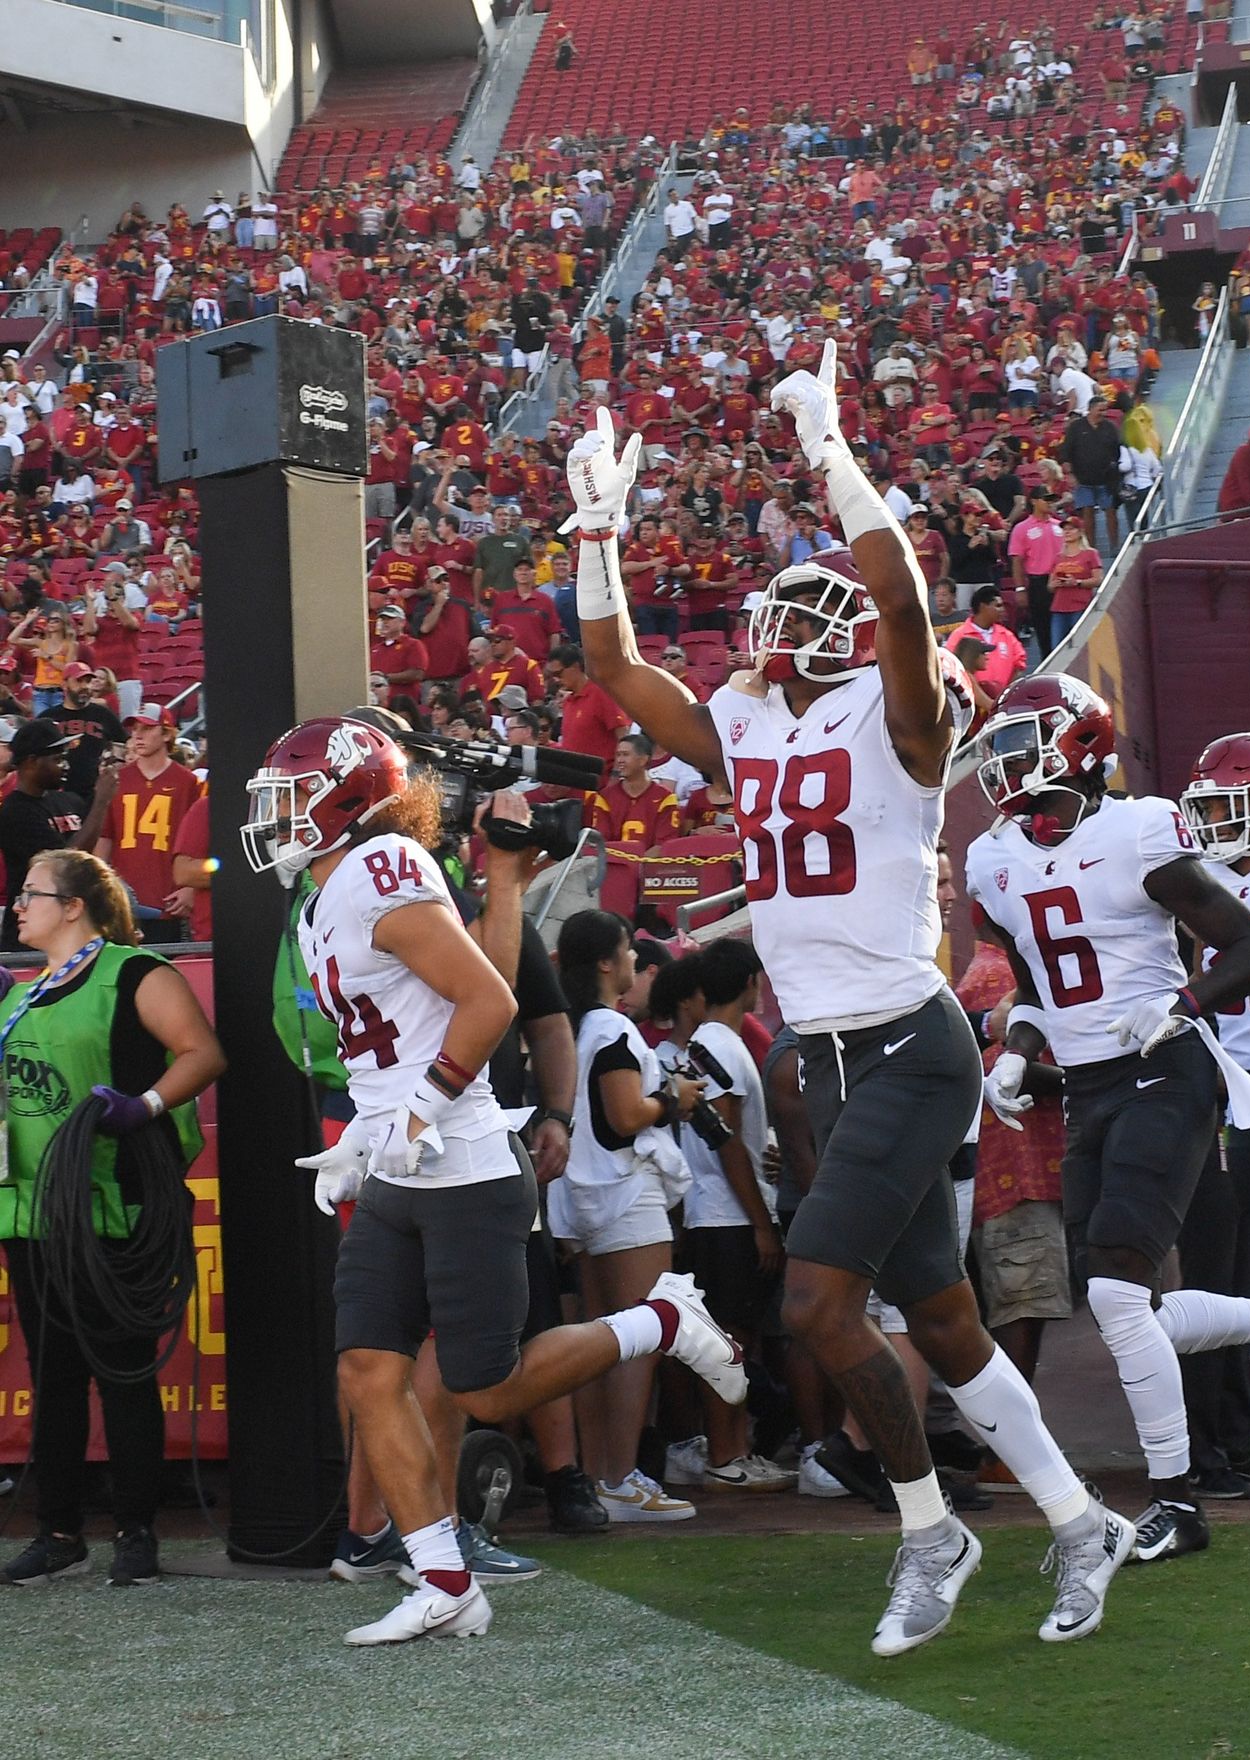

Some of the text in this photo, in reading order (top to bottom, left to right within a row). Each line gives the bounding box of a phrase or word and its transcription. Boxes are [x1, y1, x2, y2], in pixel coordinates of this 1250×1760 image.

[73, 431, 86, 447] 3
[457, 425, 473, 445] 2
[487, 671, 510, 701] 7
[119, 793, 173, 852] 14
[728, 747, 858, 903] 88
[362, 846, 423, 897] 84
[644, 877, 699, 888] NO ACCESS
[1021, 885, 1105, 1010] 6
[6, 1053, 53, 1094] FOX
[1102, 1517, 1120, 1562] NIKE
